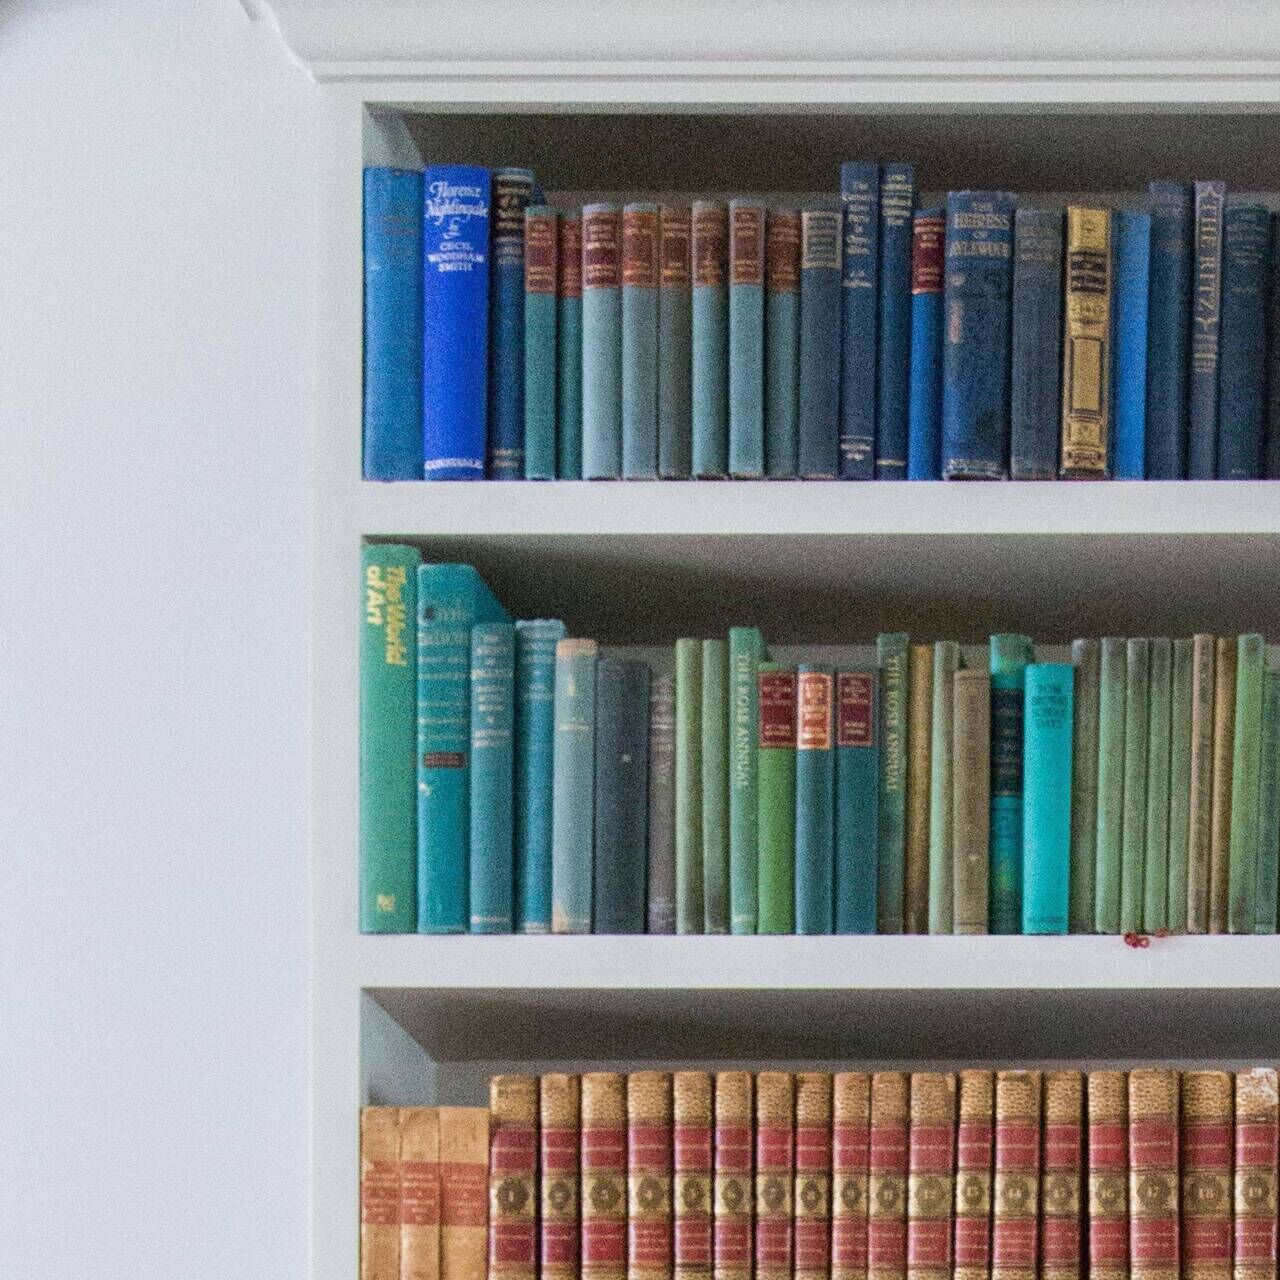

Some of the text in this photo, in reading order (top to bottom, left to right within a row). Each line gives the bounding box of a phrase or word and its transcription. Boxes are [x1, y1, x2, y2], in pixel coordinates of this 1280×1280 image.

[1200, 203, 1217, 246] THE
[1198, 256, 1217, 312] RITZ
[367, 565, 388, 625] of Art
[385, 603, 408, 668] World
[737, 653, 750, 682] THE
[886, 655, 899, 686] THE
[737, 685, 750, 724] ROSE
[886, 690, 899, 726] ROSE
